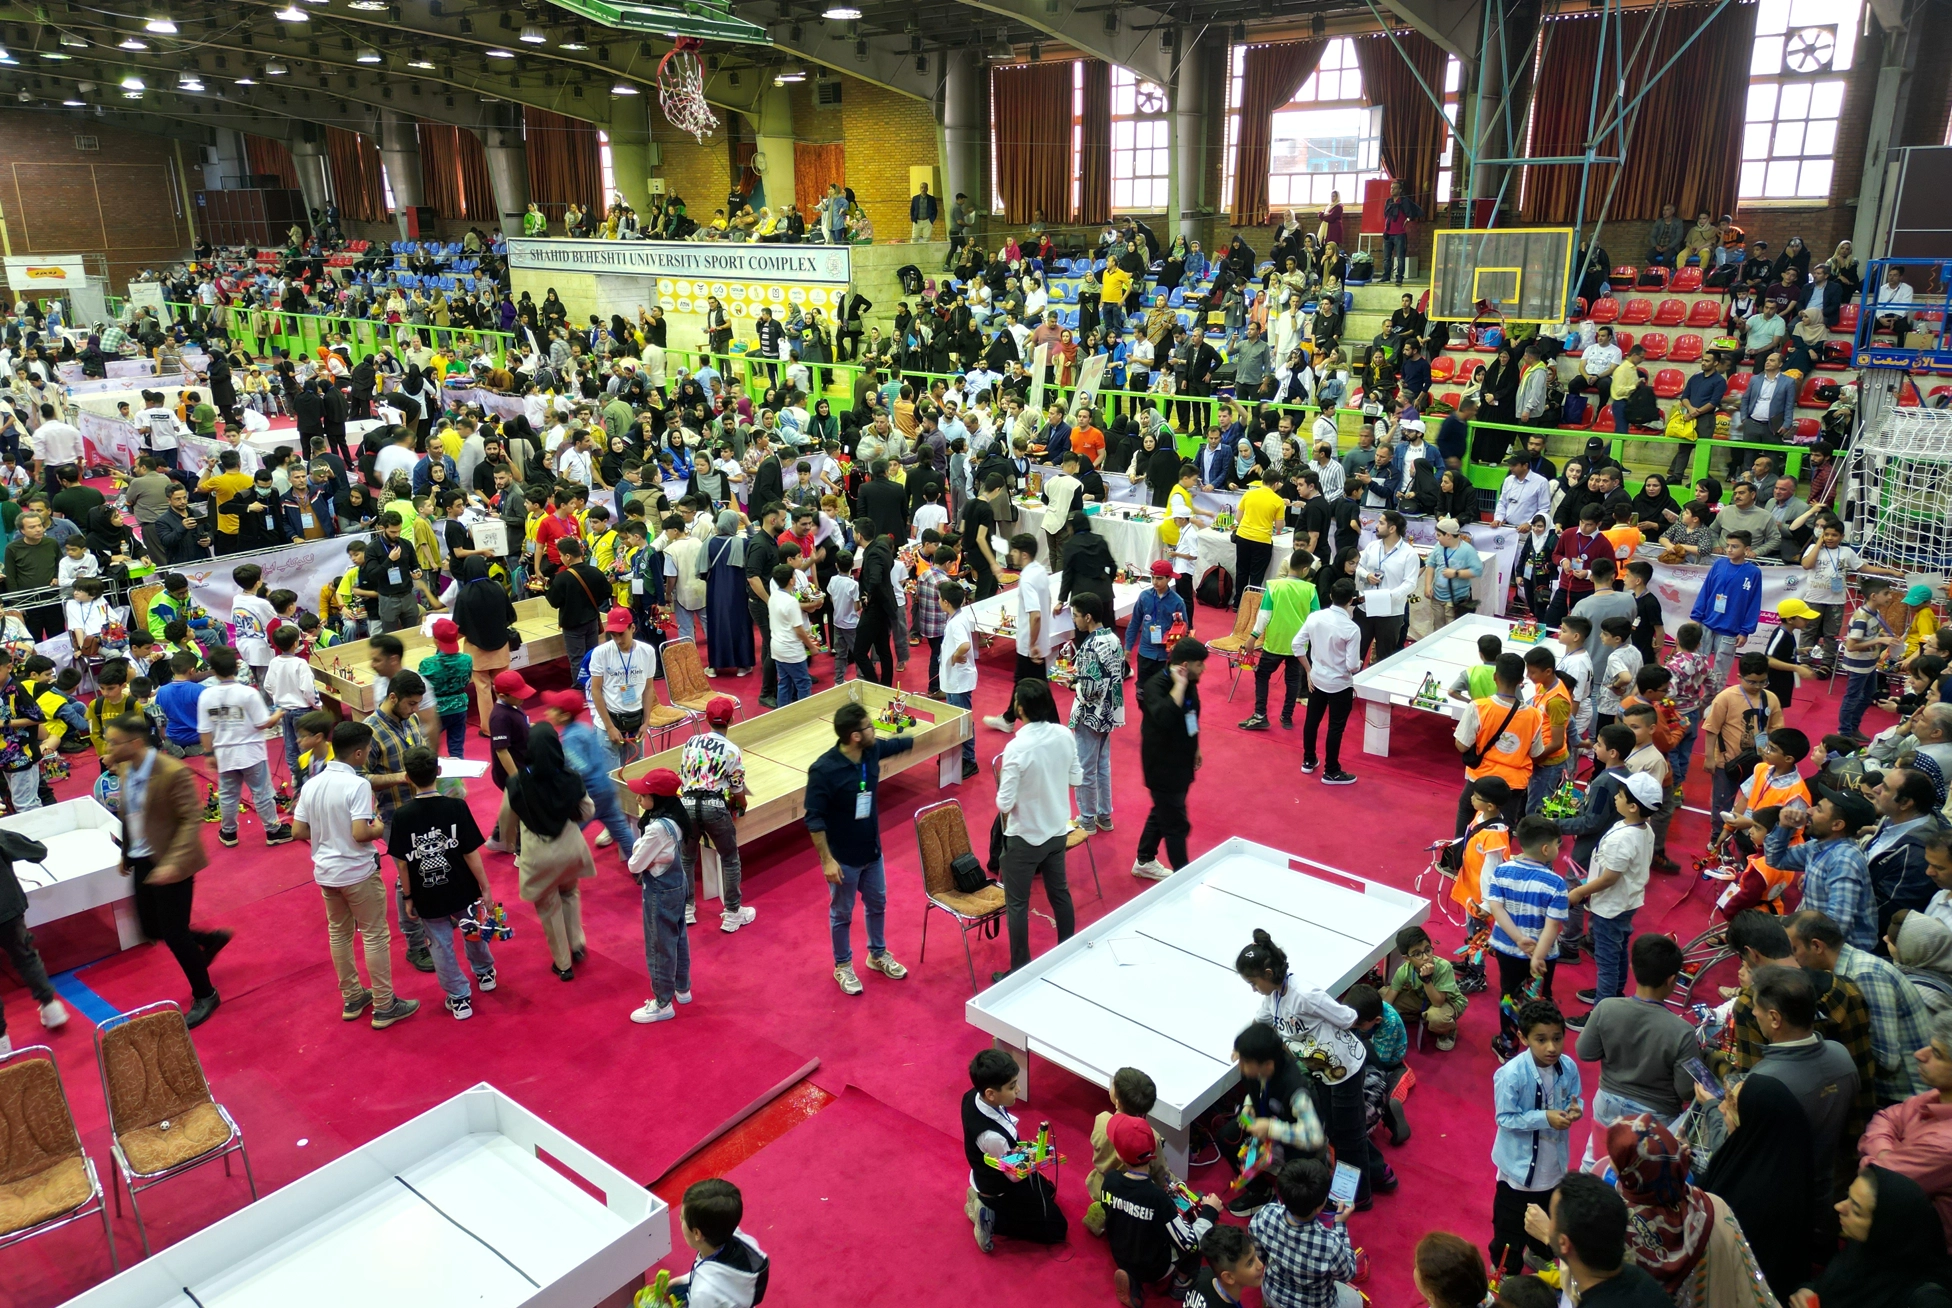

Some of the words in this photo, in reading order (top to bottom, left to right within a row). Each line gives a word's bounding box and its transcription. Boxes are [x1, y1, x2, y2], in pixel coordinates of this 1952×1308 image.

[530, 248, 570, 263] SHAHID
[572, 250, 628, 265] BEHESHTI
[630, 253, 701, 268] UNIVERSITY
[704, 255, 745, 270] SPORT
[749, 256, 818, 272] COMPLEX
[1873, 355, 1909, 366] صنعت
[261, 560, 277, 577] ایرا
[1742, 577, 1751, 590] LA
